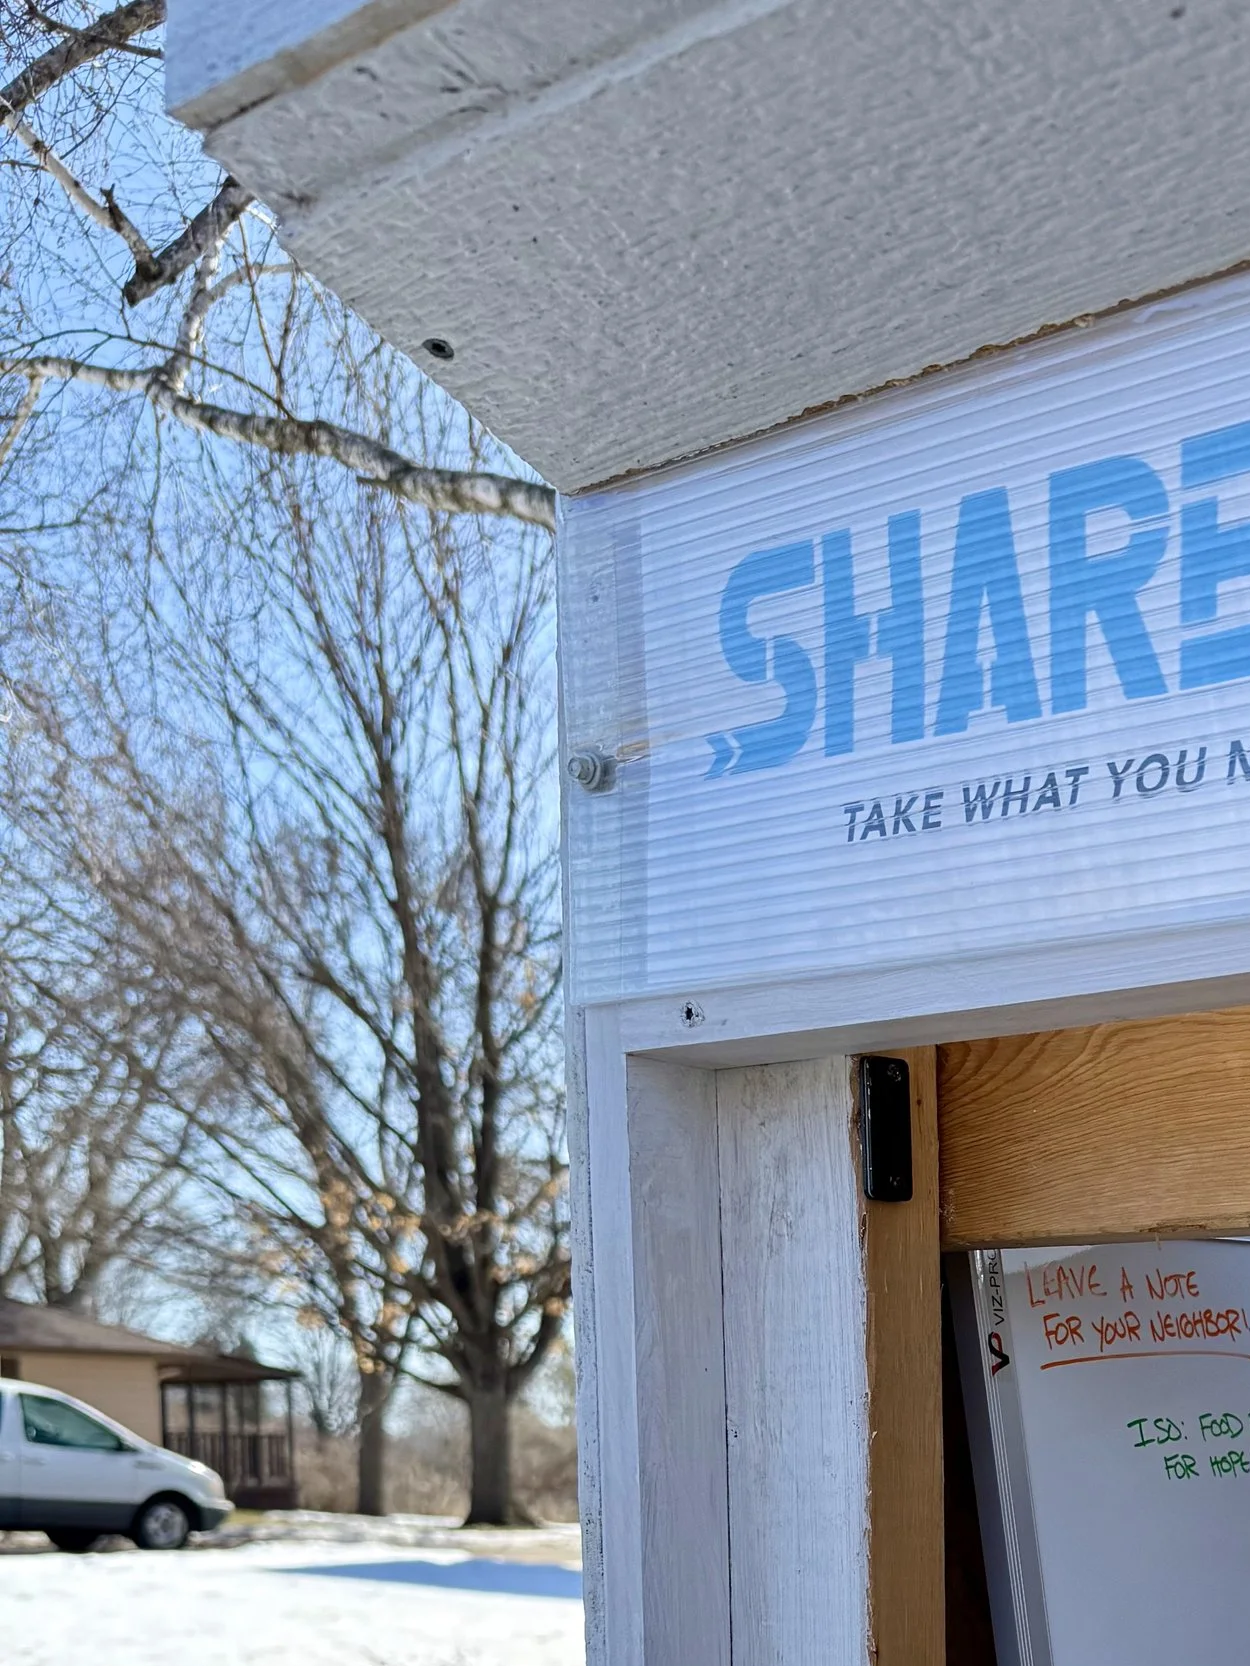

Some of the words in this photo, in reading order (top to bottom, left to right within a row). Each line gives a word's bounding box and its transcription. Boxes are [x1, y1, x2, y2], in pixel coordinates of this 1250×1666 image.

[843, 790, 943, 843] TAKE
[963, 767, 1089, 824] WHAT
[1106, 746, 1207, 799] YOU
[1024, 1261, 1107, 1308] LEAVE
[1120, 1266, 1134, 1303] A
[1146, 1268, 1200, 1301] NOTE
[1043, 1313, 1085, 1350] FOR
[1091, 1311, 1141, 1352] YOUR
[1150, 1308, 1250, 1342] NEIGHBOR!
[1127, 1417, 1188, 1448] ISO:
[1199, 1412, 1244, 1441] FOOD
[1164, 1453, 1200, 1480] FOR
[1210, 1450, 1250, 1479] HOPE
